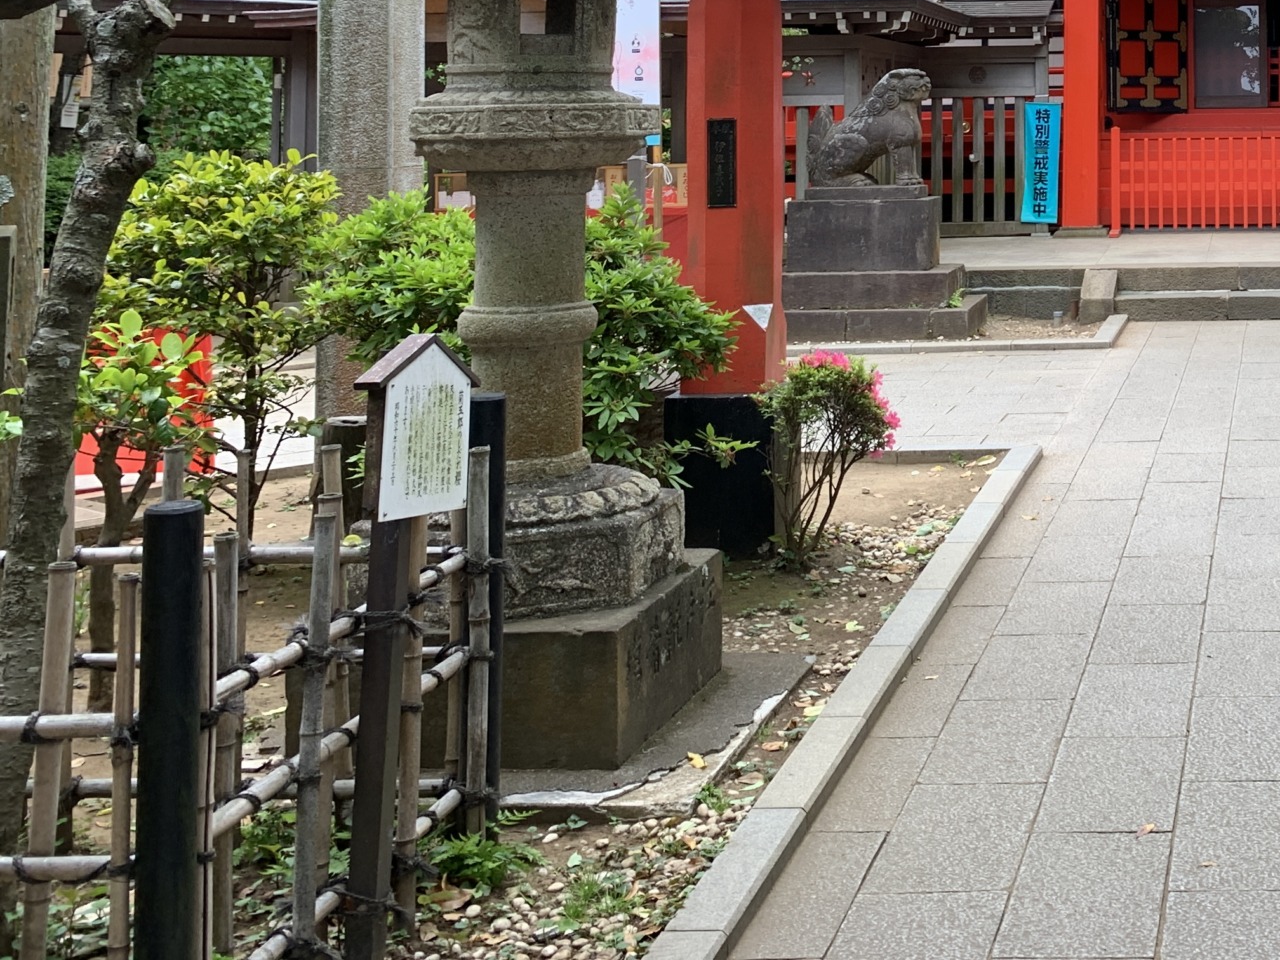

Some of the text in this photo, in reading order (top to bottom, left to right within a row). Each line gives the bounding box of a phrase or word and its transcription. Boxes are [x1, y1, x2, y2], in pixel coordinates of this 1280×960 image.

[1033, 108, 1051, 217] 特別警戒実施中
